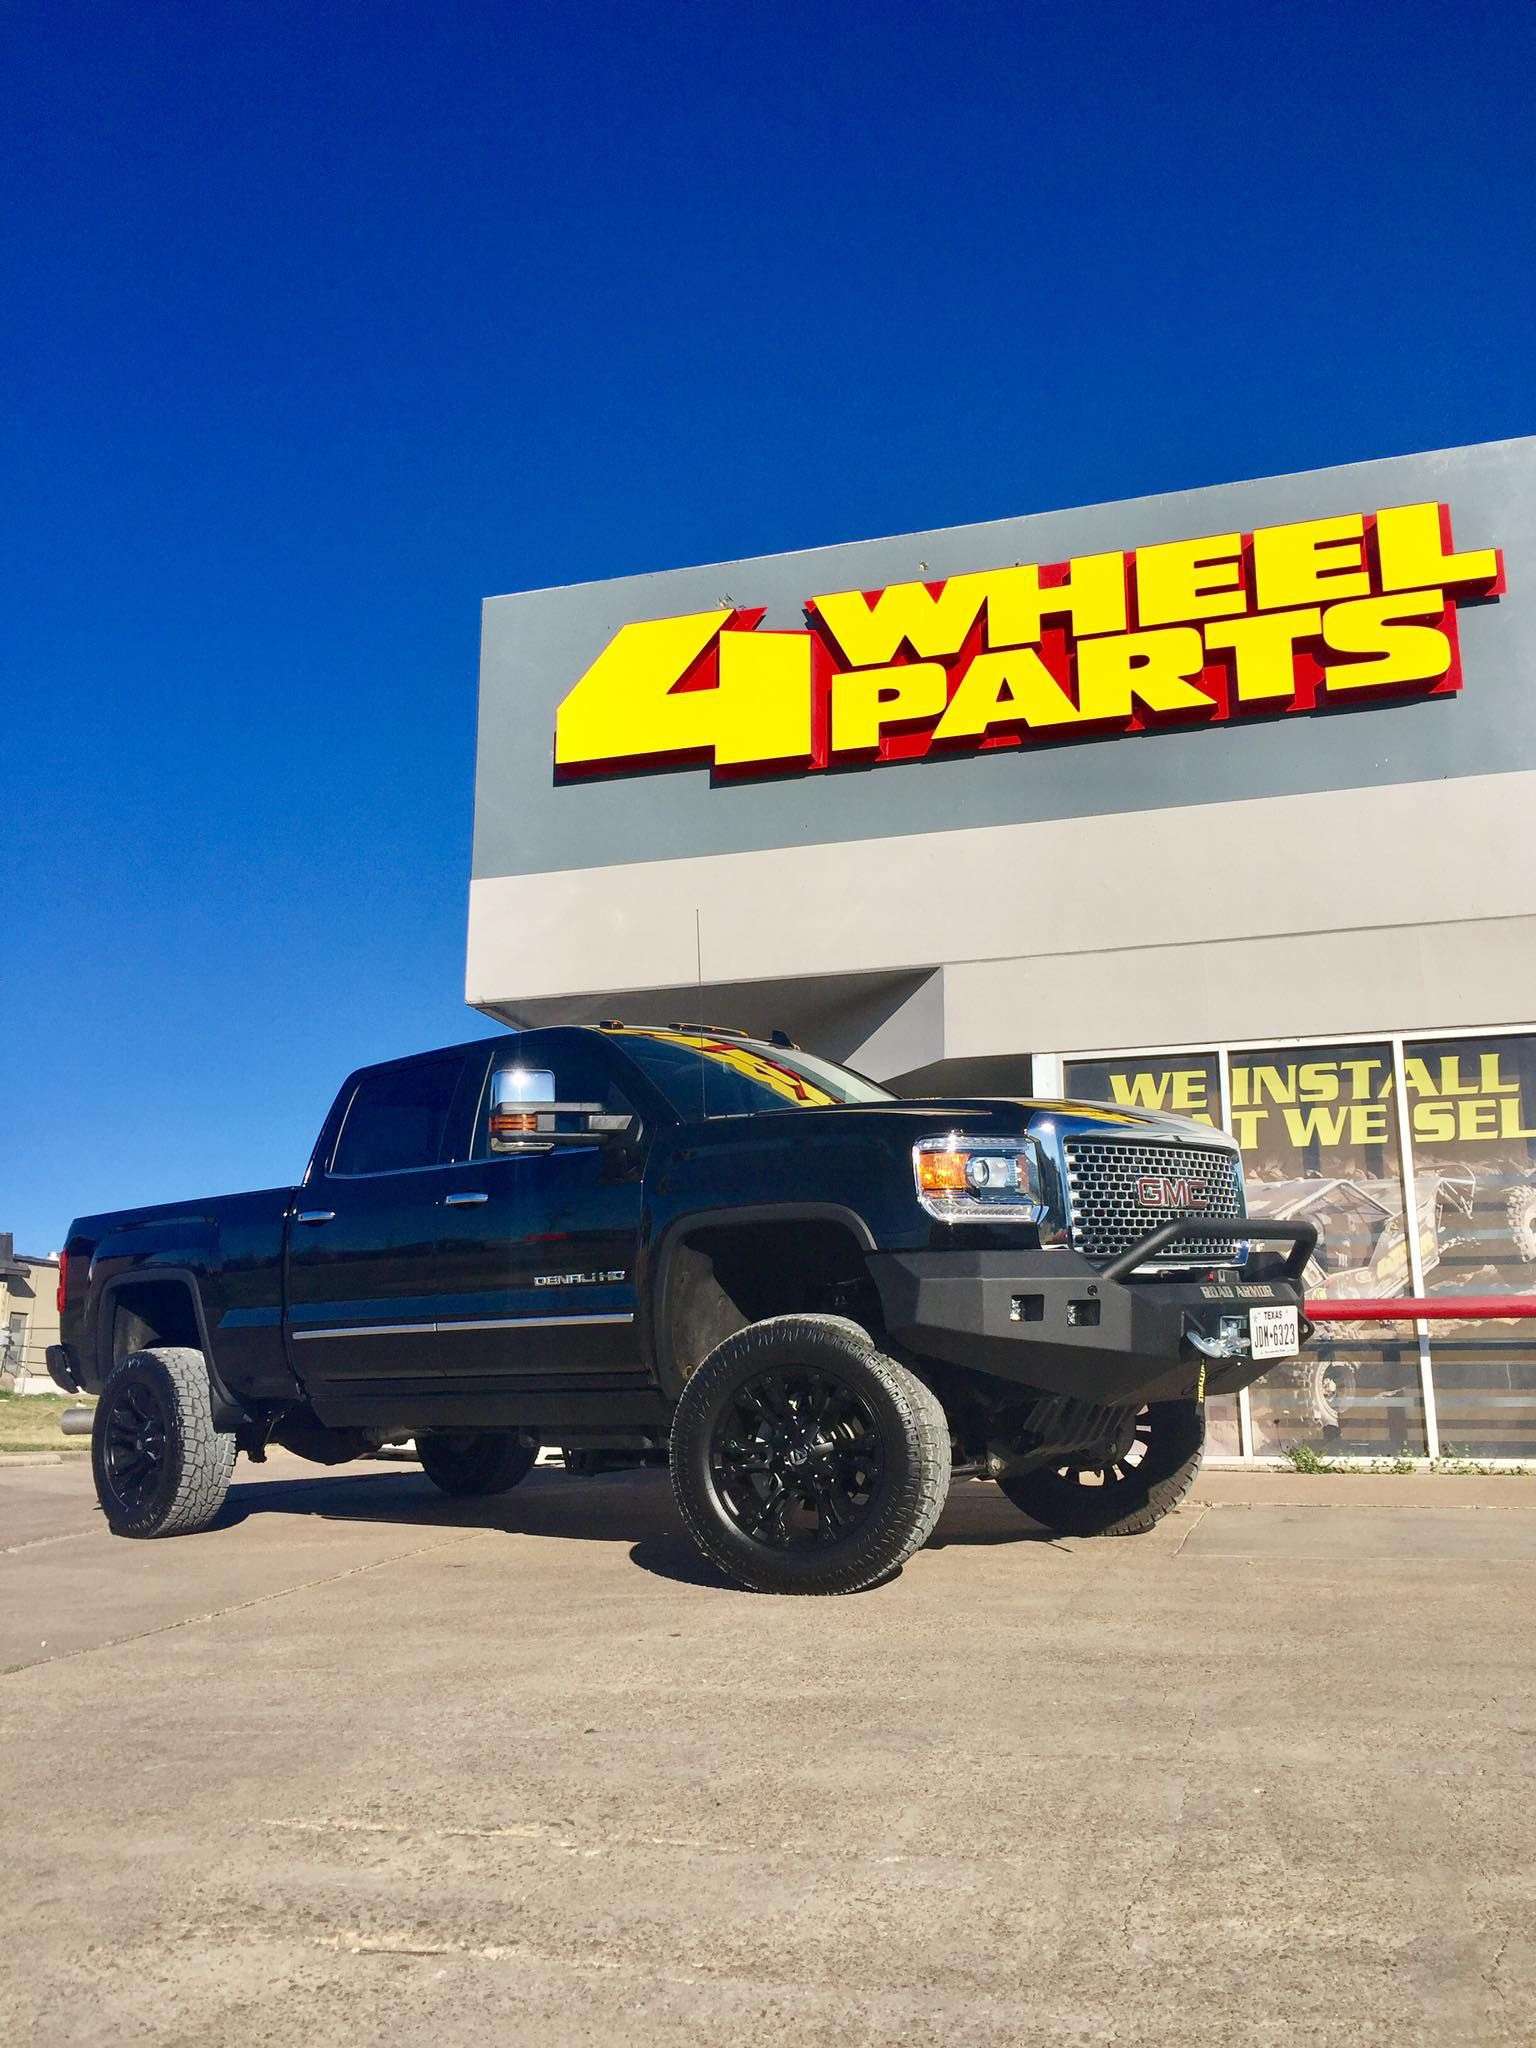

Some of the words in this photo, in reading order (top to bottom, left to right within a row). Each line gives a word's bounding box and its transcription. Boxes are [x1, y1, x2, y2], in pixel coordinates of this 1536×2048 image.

[556, 606, 813, 767] 4
[813, 502, 1498, 667] WHEEL
[831, 589, 1453, 752] PARTS
[1109, 1070, 1208, 1110] WE
[1231, 1053, 1520, 1107] INSTALL
[1282, 1104, 1389, 1148] WE
[1137, 1177, 1208, 1208] GMC
[534, 1273, 596, 1287] DENALI
[1200, 1285, 1235, 1299] ROAD
[1235, 1285, 1276, 1297] ARMOR
[1263, 1310, 1283, 1321] TEXAS
